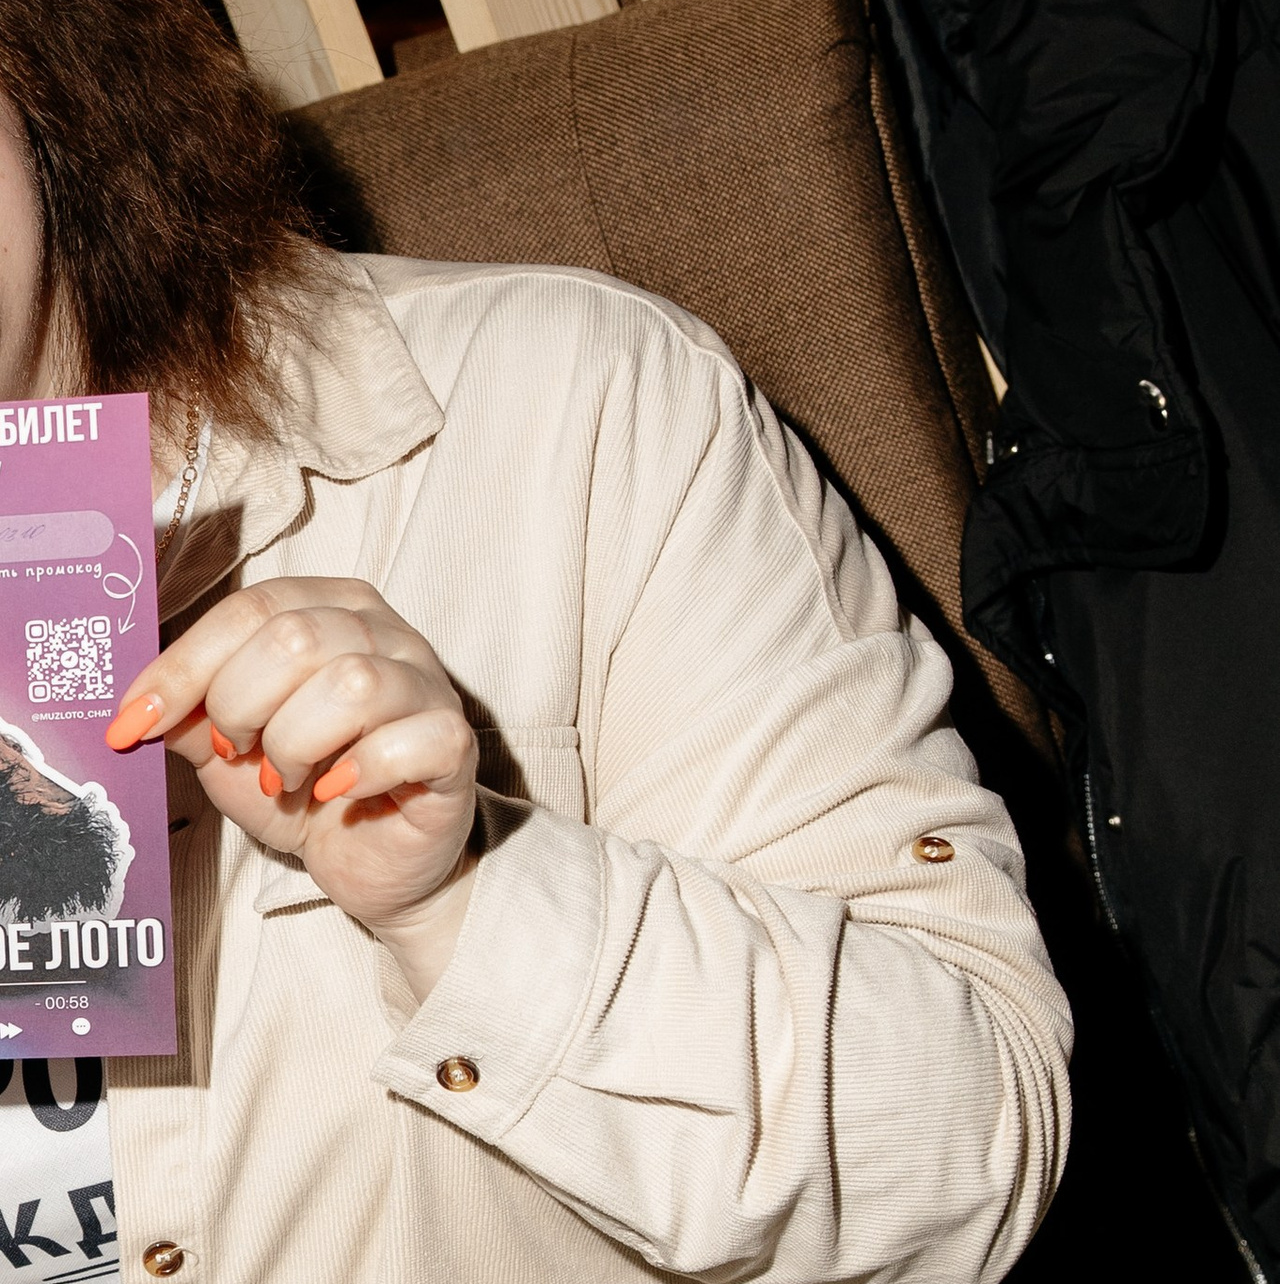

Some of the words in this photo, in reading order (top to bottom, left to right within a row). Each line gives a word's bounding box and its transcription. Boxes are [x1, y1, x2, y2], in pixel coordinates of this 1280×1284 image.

[25, 562, 102, 582] промокод
[31, 709, 112, 722] @MUZLOTO_CHAT
[44, 918, 165, 971] ЛОТО
[45, 996, 90, 1011] 00:58
